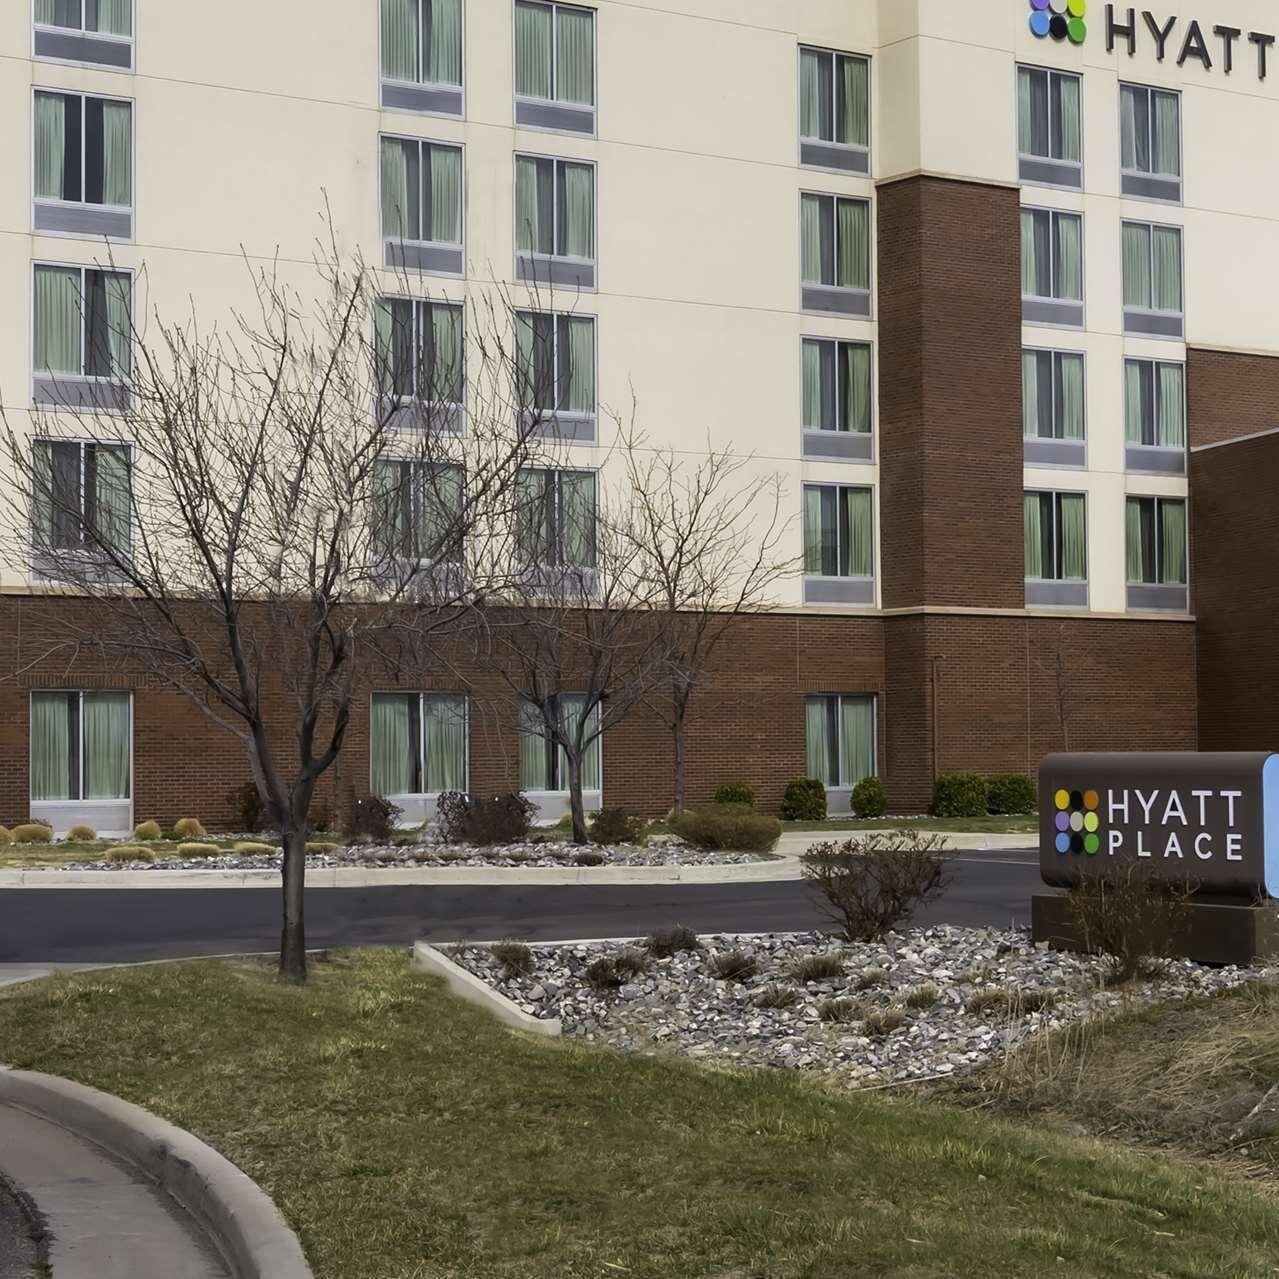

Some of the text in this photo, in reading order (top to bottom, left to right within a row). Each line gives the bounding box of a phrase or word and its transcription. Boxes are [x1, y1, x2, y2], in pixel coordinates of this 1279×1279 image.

[1104, 3, 1276, 81] HYATT
[1108, 789, 1242, 827] HYATT
[1108, 830, 1243, 861] PLACE
